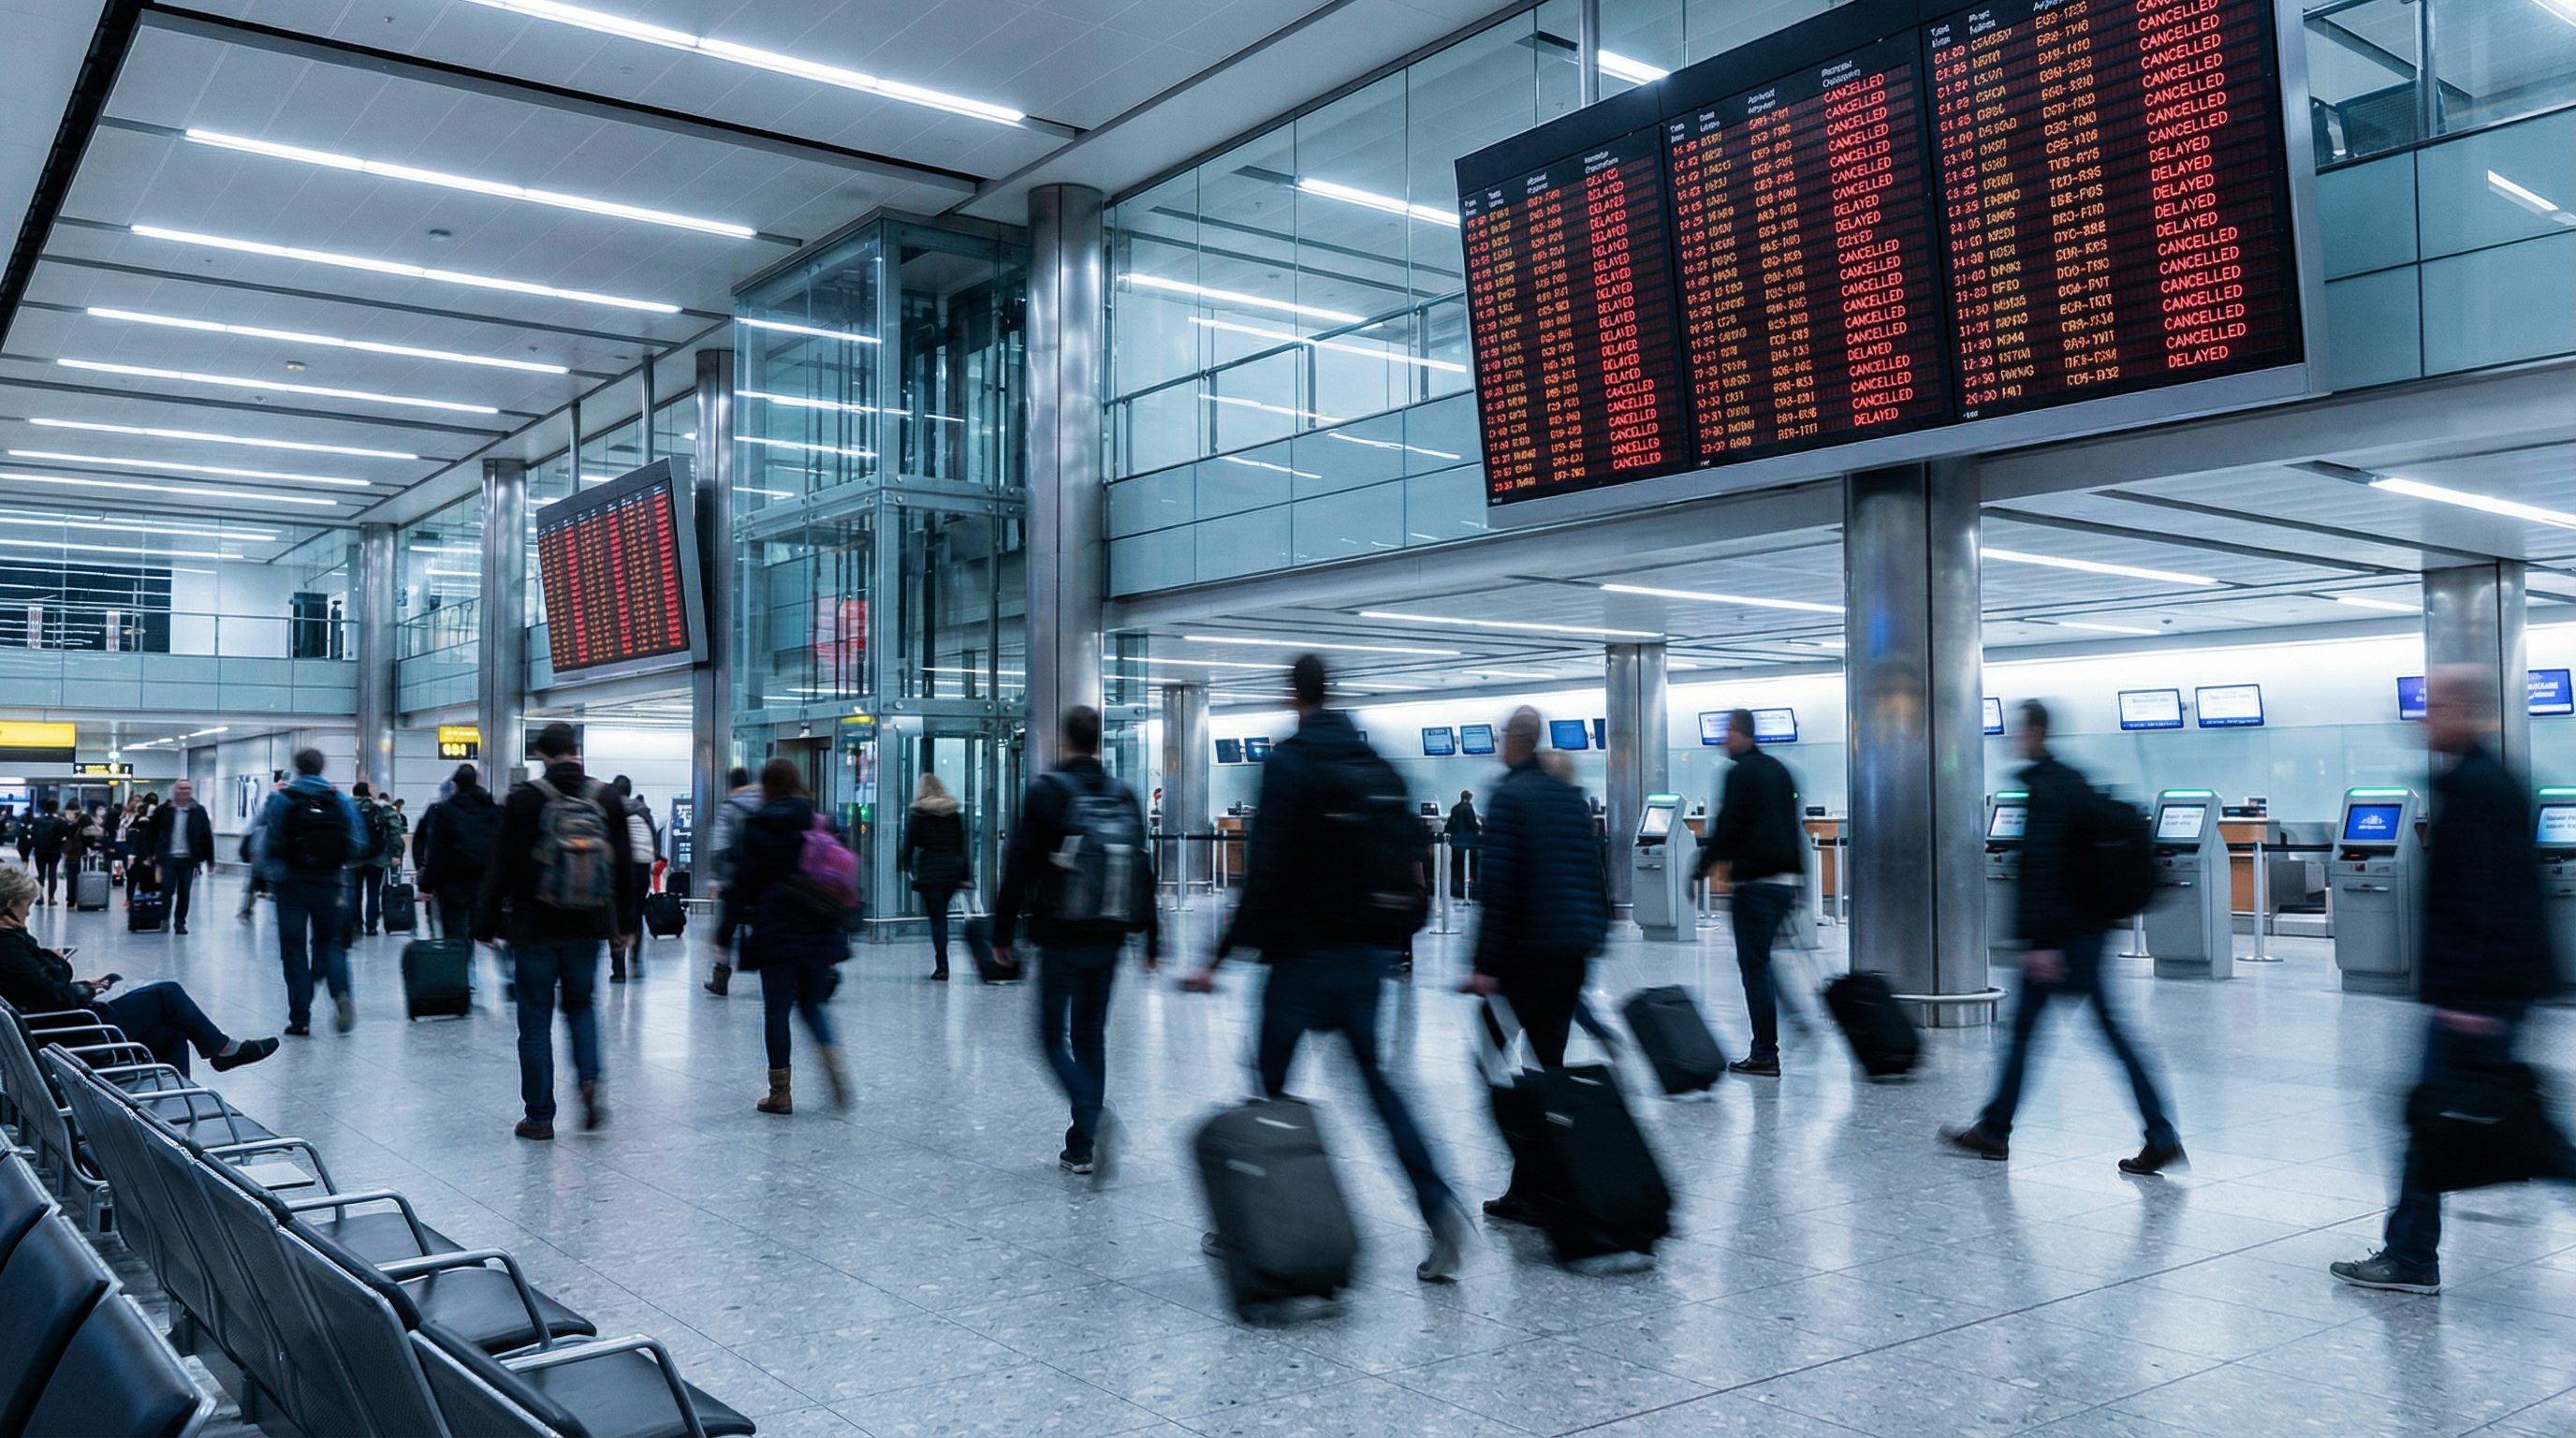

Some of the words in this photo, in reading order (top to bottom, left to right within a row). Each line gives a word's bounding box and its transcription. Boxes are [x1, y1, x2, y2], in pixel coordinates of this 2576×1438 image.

[2138, 0, 2217, 31] CANCELLED
[2140, 14, 2219, 51] CANCELLED
[2142, 34, 2220, 69] CANCELLED
[2143, 53, 2222, 87] CANCELLED
[1824, 74, 1883, 103] CANCELLED
[2144, 73, 2224, 106] CANCELLED
[1825, 91, 1885, 119] CANCELLED
[2146, 92, 2226, 125] CANCELLED
[1827, 107, 1887, 135] CANCELLED
[2148, 111, 2227, 143] CANCELLED
[1829, 124, 1888, 151] CANCELLED
[2150, 136, 2210, 162] DELAYED
[1830, 140, 1890, 167] CANCELLED
[1832, 157, 1891, 183] CANCELLED
[2152, 154, 2212, 181] DELAYED
[1833, 174, 1893, 200] CANCELLED
[2153, 174, 2214, 200] DELAYED
[1835, 195, 1879, 216] DELAYED
[2156, 193, 2216, 218] DELAYED
[1836, 212, 1881, 232] DELAYED
[2157, 212, 2217, 237] DELAYED
[1838, 240, 1898, 264] CANCELLED
[2159, 227, 2237, 256] CANCELLED
[1840, 256, 1900, 280] CANCELLED
[2160, 246, 2239, 274] CANCELLED
[1842, 272, 1902, 296] CANCELLED
[2161, 266, 2240, 293] CANCELLED
[1843, 288, 1903, 312] CANCELLED
[2163, 285, 2242, 312] CANCELLED
[1845, 306, 1905, 329] CANCELLED
[2165, 304, 2244, 330] CANCELLED
[1847, 322, 1906, 345] CANCELLED
[2167, 323, 2246, 348] CANCELLED
[1848, 342, 1892, 360] DELAYED
[2169, 346, 2228, 368] DELAYED
[1850, 355, 1910, 376] CANCELLED
[1852, 372, 1911, 392] CANCELLED
[1852, 389, 1912, 409] CANCELLED
[1854, 408, 1898, 426] DELAYED
